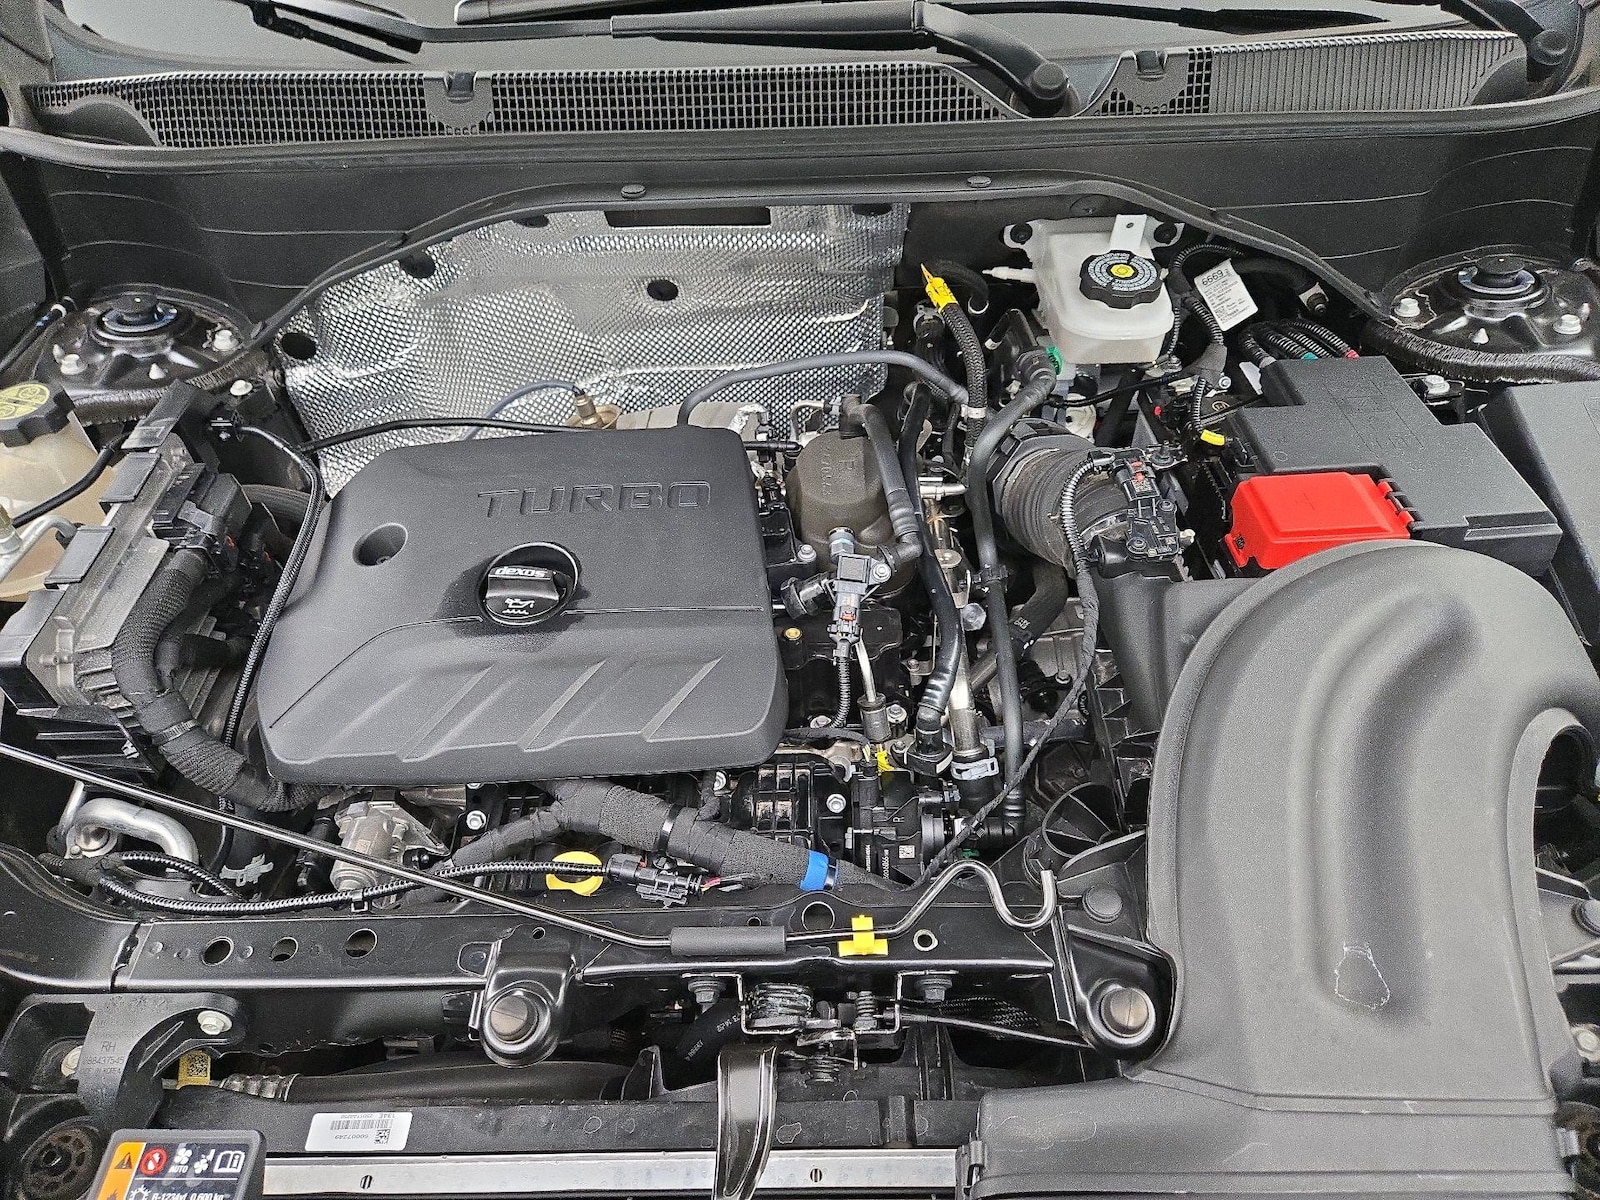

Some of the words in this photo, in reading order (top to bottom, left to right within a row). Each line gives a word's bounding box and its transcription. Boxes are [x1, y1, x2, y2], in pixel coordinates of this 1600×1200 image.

[1201, 269, 1224, 286] 6669
[478, 481, 710, 518] TURBO
[494, 566, 548, 578] dexos
[101, 1040, 116, 1052] RH
[169, 1165, 188, 1173] AUTO
[190, 1192, 212, 1200] 0600
